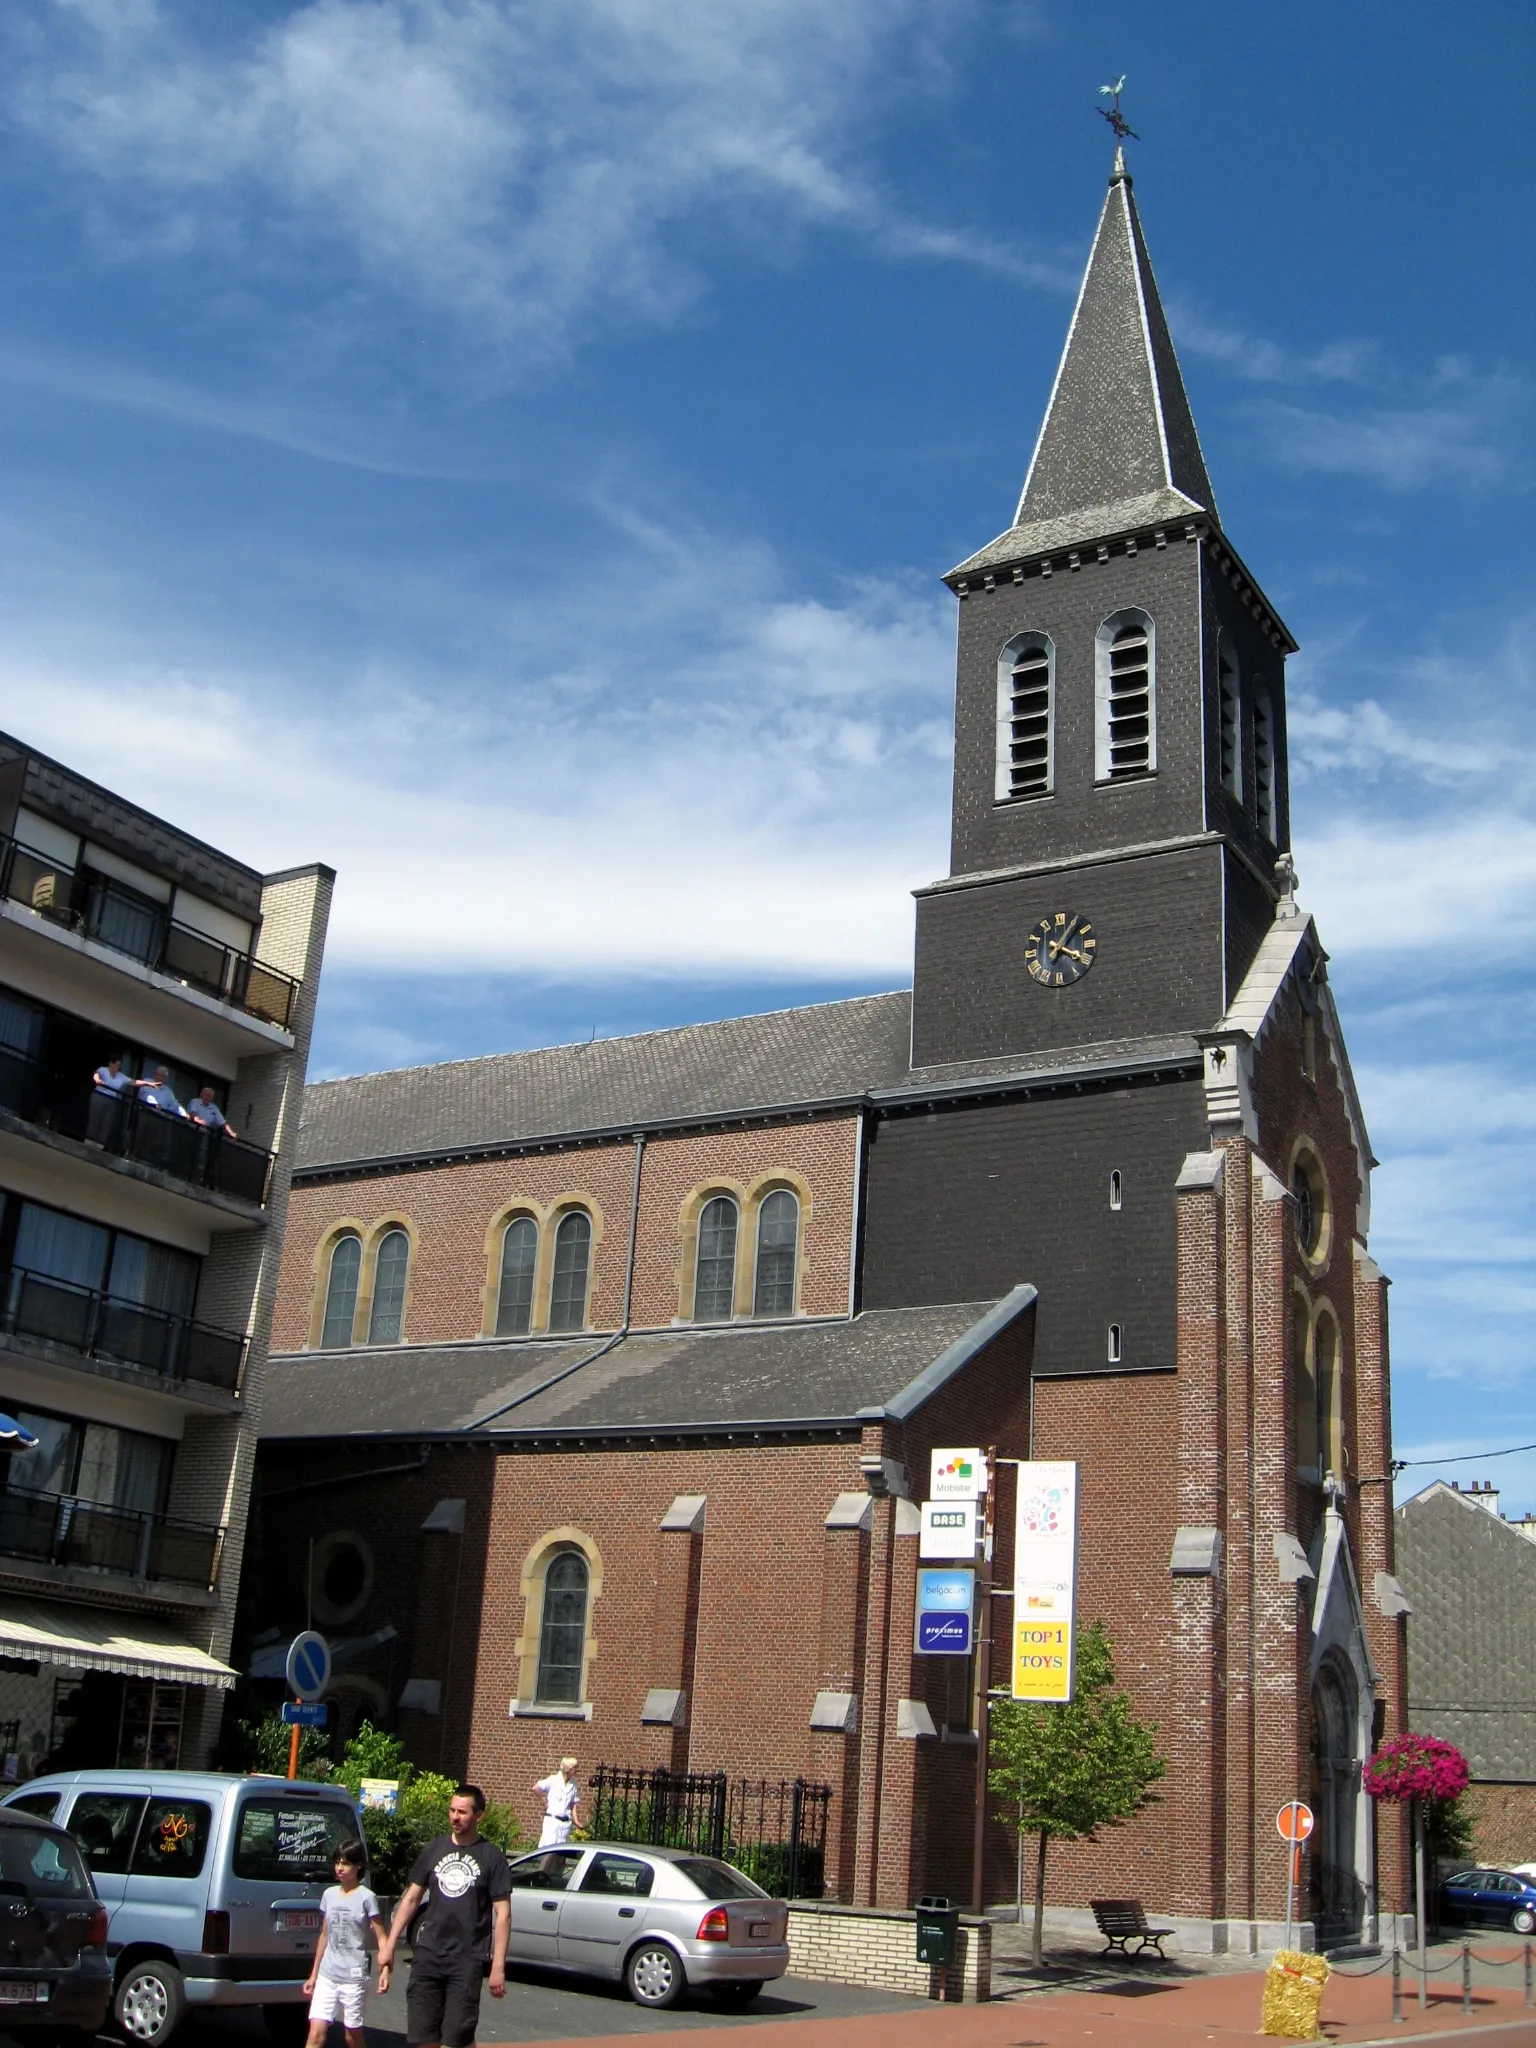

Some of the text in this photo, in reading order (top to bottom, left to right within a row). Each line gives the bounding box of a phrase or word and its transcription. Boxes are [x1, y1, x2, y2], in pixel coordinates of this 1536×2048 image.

[936, 1484, 971, 1492] Mobistar
[933, 1515, 963, 1525] BASE
[926, 1586, 966, 1596] belgacom
[1021, 1629, 1063, 1643] TOP 1
[1020, 1655, 1062, 1668] TOYS
[293, 1837, 317, 1854] Sport
[461, 1854, 481, 1876] JEANS
[11, 1984, 33, 1998] 875
